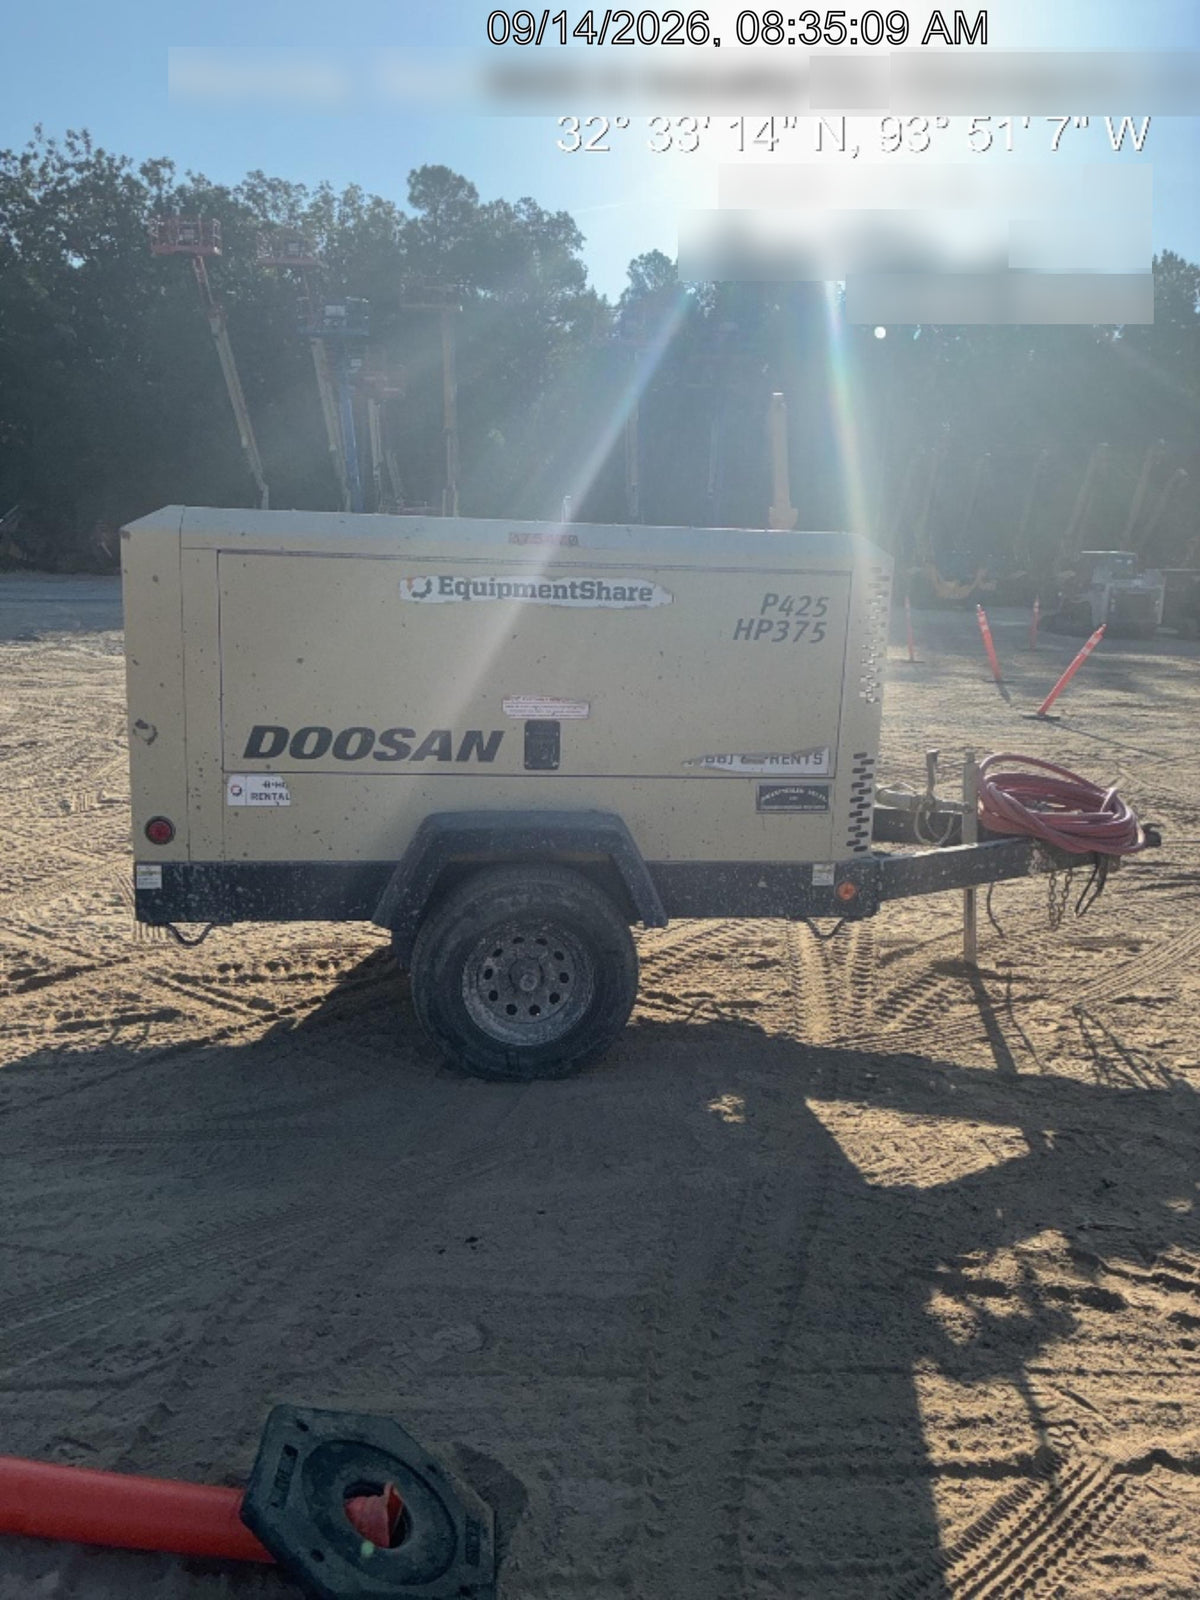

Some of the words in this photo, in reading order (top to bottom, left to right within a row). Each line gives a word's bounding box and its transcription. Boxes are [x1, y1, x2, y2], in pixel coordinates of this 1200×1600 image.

[438, 576, 653, 602] EquipmentShare
[760, 592, 829, 618] P425
[732, 618, 828, 644] HP375
[243, 724, 505, 763] DOOSAN
